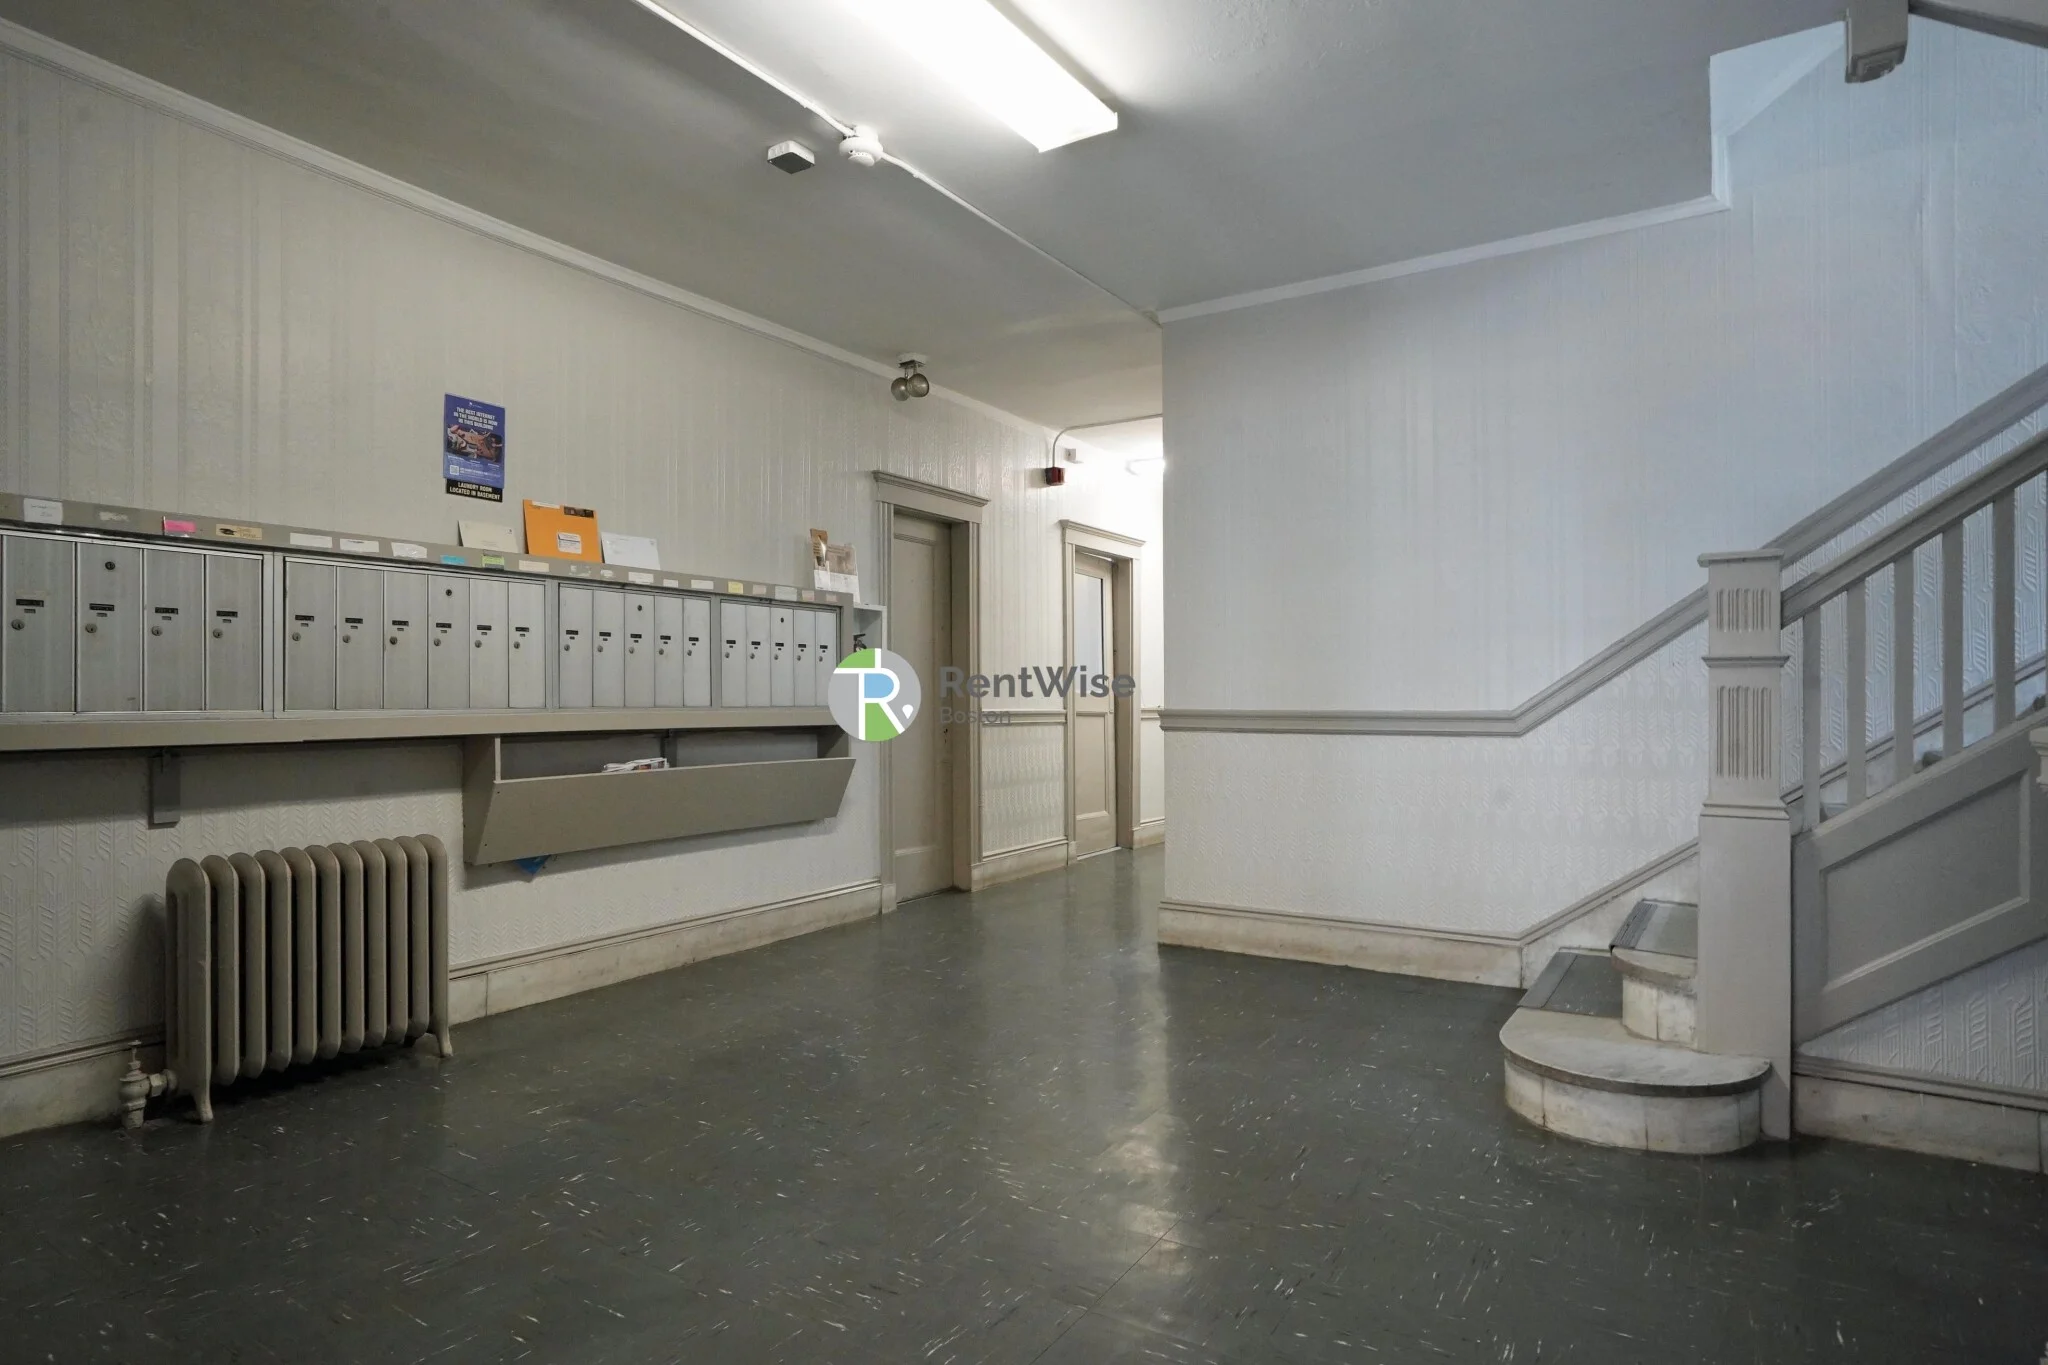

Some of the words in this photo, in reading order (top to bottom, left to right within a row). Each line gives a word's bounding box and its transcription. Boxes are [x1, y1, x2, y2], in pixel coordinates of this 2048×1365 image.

[458, 482, 479, 490] LAUNDRY
[450, 487, 471, 495] LOCATED
[477, 491, 500, 500] BASEMENT
